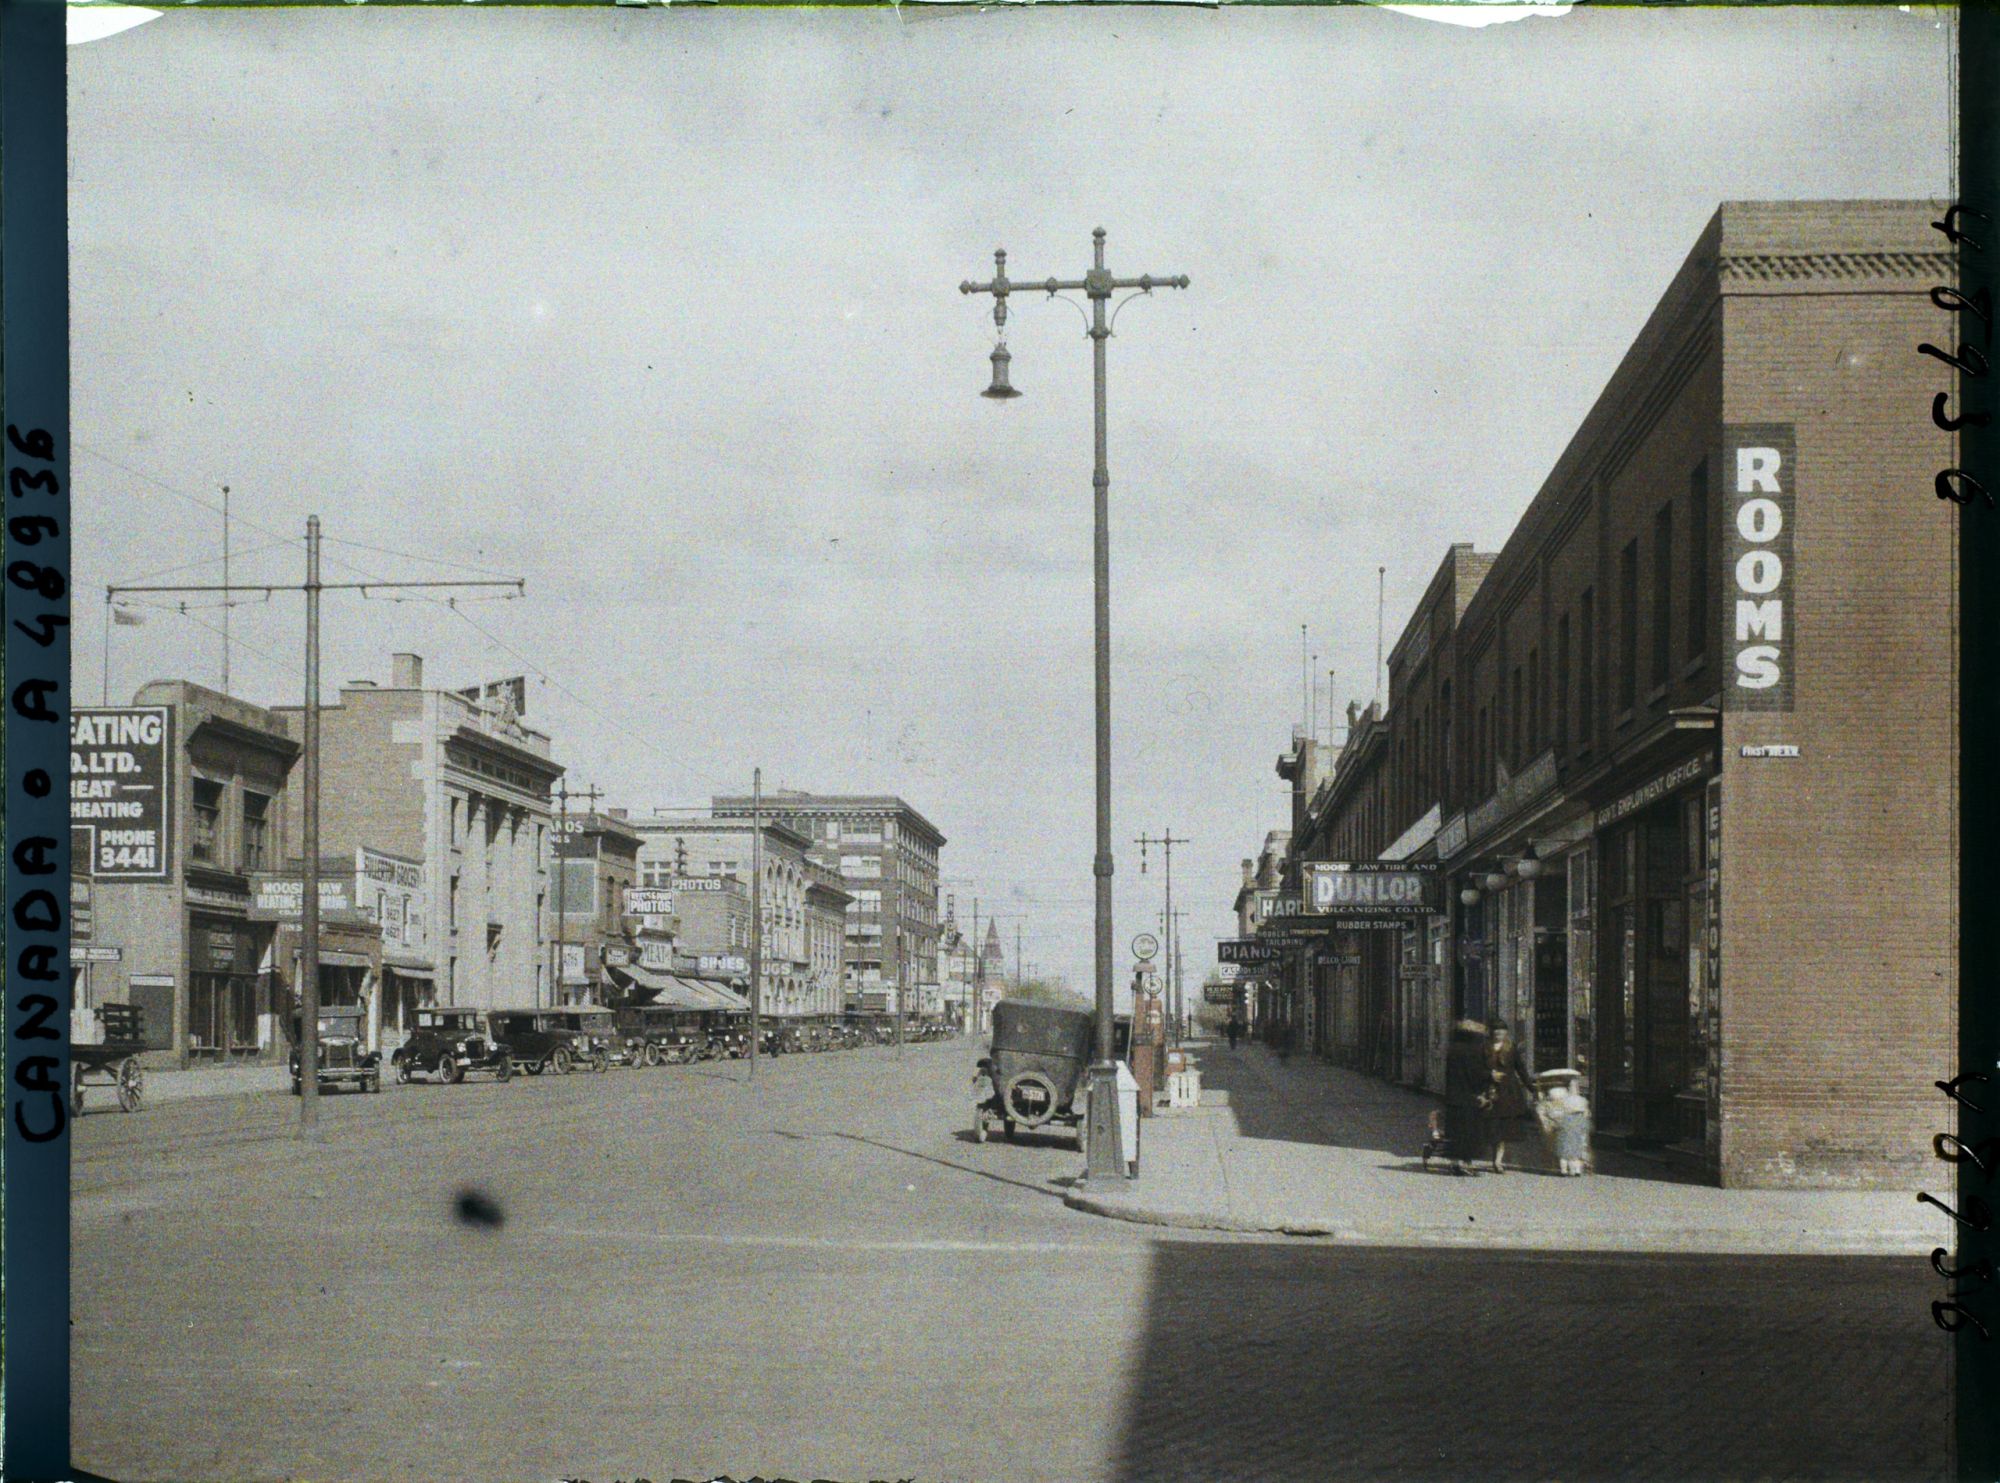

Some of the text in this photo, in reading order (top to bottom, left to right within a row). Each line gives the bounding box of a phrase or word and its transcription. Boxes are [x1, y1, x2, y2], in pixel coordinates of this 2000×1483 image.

[1736, 447, 1783, 689] ROOMS
[1617, 776, 1664, 816] EMPLOYMENT
[71, 802, 144, 818] HEATING
[101, 829, 156, 846] PHONE
[101, 847, 156, 869] 3441
[1315, 863, 1437, 872] MOOSE JAW TIRE AND
[671, 879, 721, 891] PHOTOS
[1317, 876, 1422, 903] DUNLOP
[630, 900, 672, 913] PHOTOS
[1317, 906, 1392, 914] VULCANIZING
[1336, 920, 1408, 930] RUBBER STAMPS
[1221, 944, 1281, 960] PIANOS
[1708, 807, 1720, 1099] EMPLOYMENT
[699, 955, 746, 971] SHOES
[12, 836, 65, 1144] CANADA
